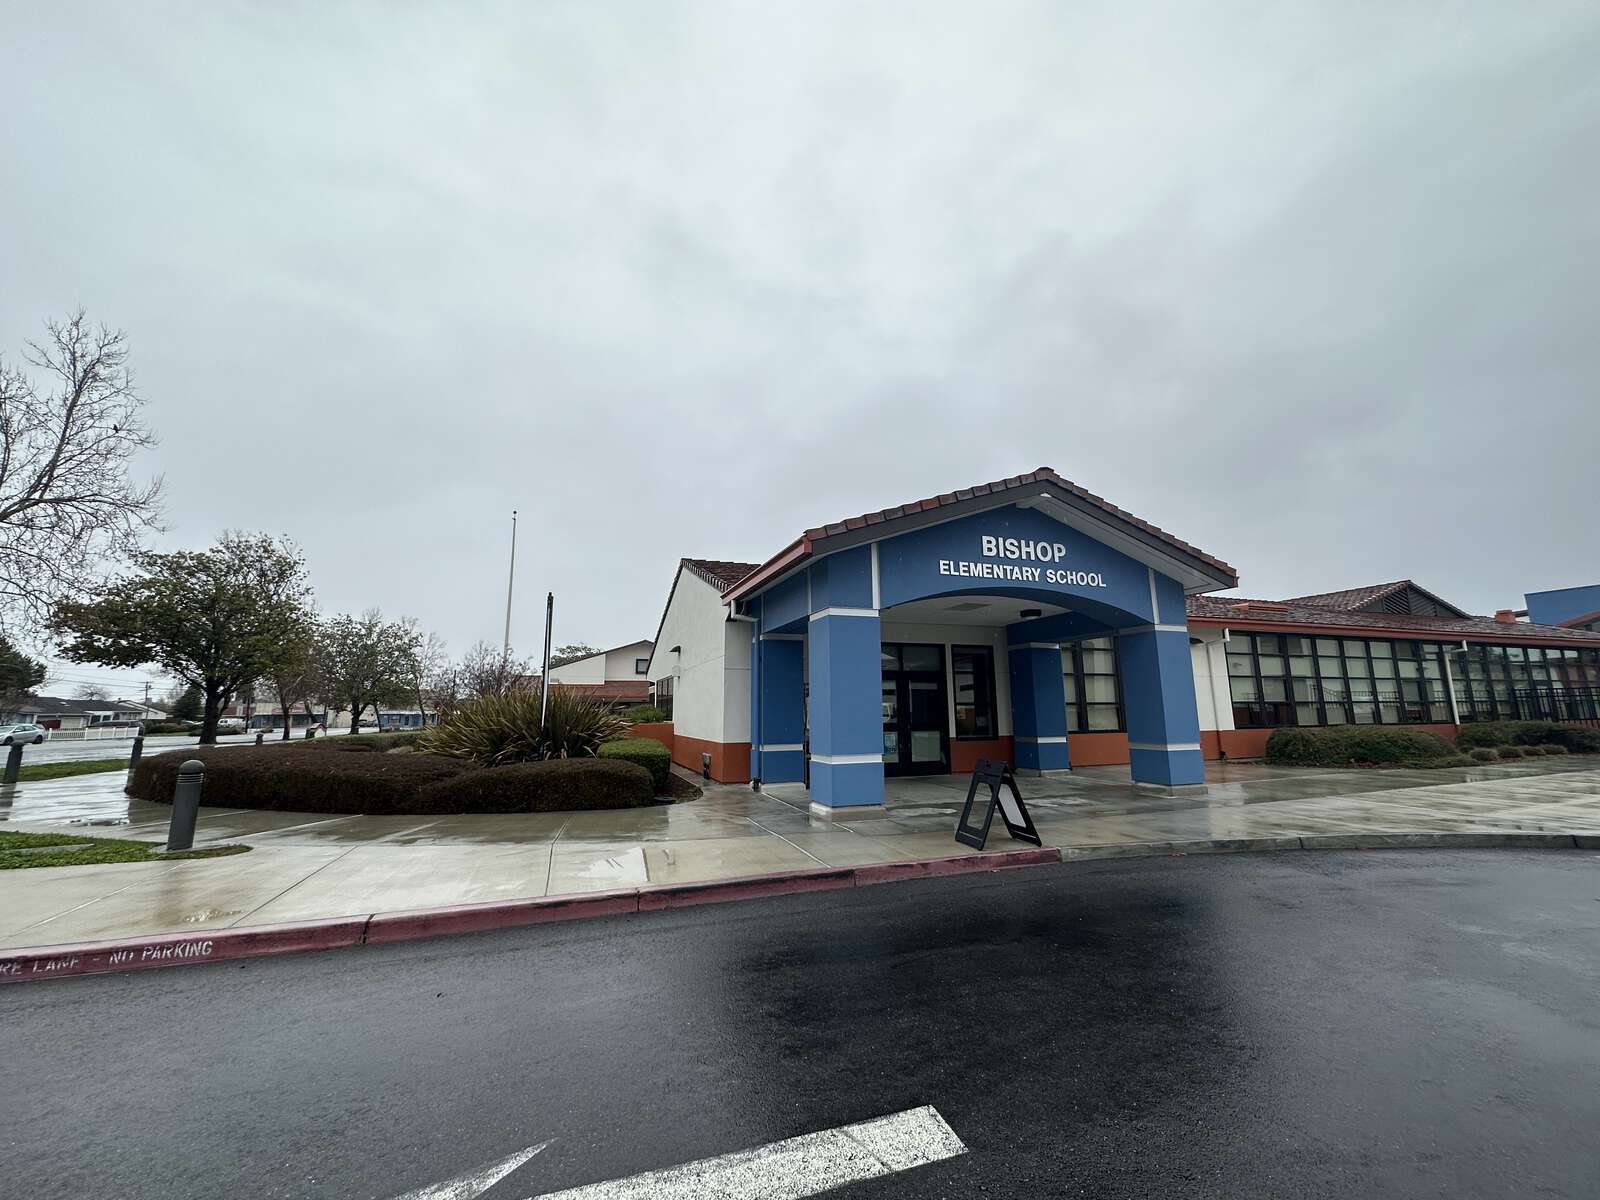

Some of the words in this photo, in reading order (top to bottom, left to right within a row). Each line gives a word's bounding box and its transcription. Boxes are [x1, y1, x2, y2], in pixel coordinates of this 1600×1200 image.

[981, 535, 1066, 563] BISHOP
[939, 559, 1041, 582] ELEMENTARY
[1046, 569, 1107, 587] SCHOOL
[141, 940, 213, 961] PARKING
